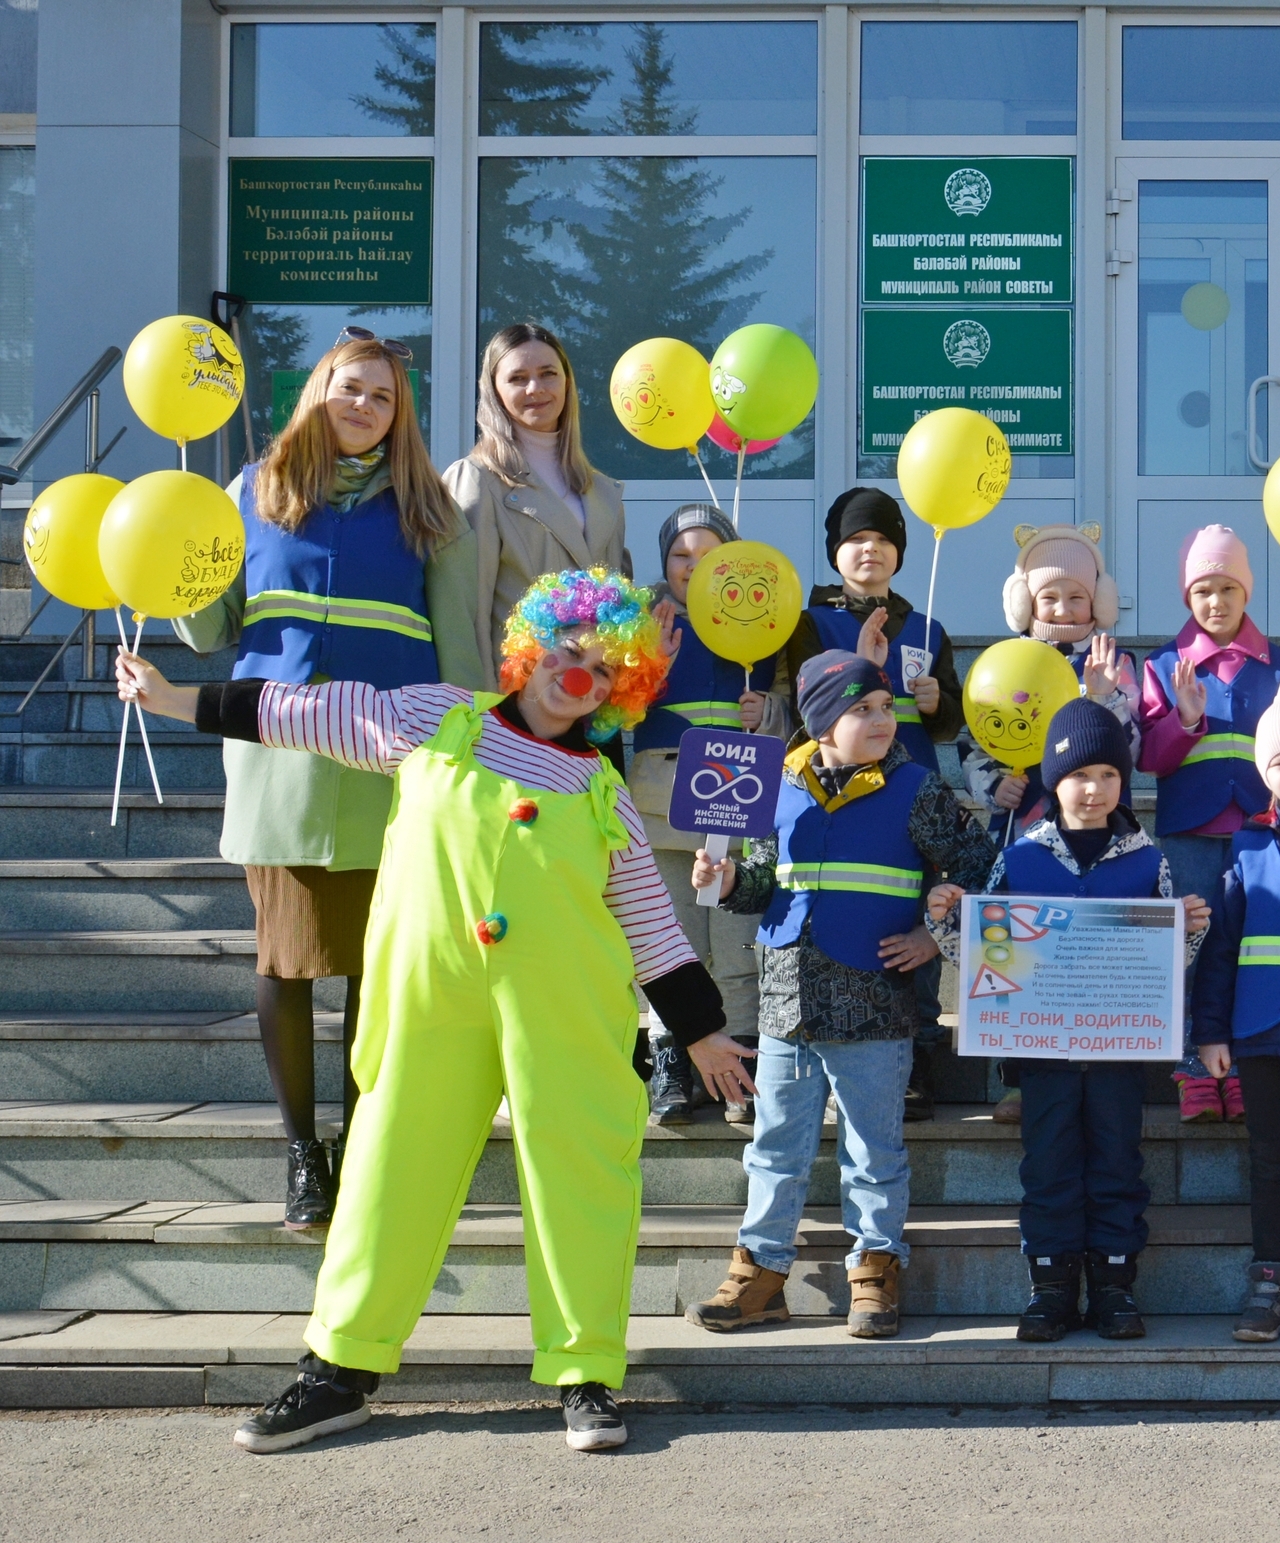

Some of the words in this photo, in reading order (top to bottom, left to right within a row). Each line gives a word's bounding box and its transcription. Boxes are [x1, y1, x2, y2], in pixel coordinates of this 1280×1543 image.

[246, 205, 349, 223] Муниципаль
[353, 207, 414, 224] районы
[266, 227, 328, 241] Бәләбәй
[333, 227, 393, 244] районы
[243, 249, 354, 264] территориаль
[971, 255, 1021, 270] РАЙОНЫ
[881, 281, 959, 296] МУНИЦИПАЛЬ
[964, 278, 1001, 294] РАЙОН
[1005, 281, 1053, 294] СОВЕТЫ
[705, 742, 757, 764] ЮИД
[694, 809, 749, 821] ИНСПЕКТОР
[709, 803, 740, 812] ЮНЫЙ
[694, 817, 747, 829] ДВИЖЕНИЯ
[979, 1034, 1162, 1052] ТЫ_ТОЖЕ_РОДИТЕЛЬ!
